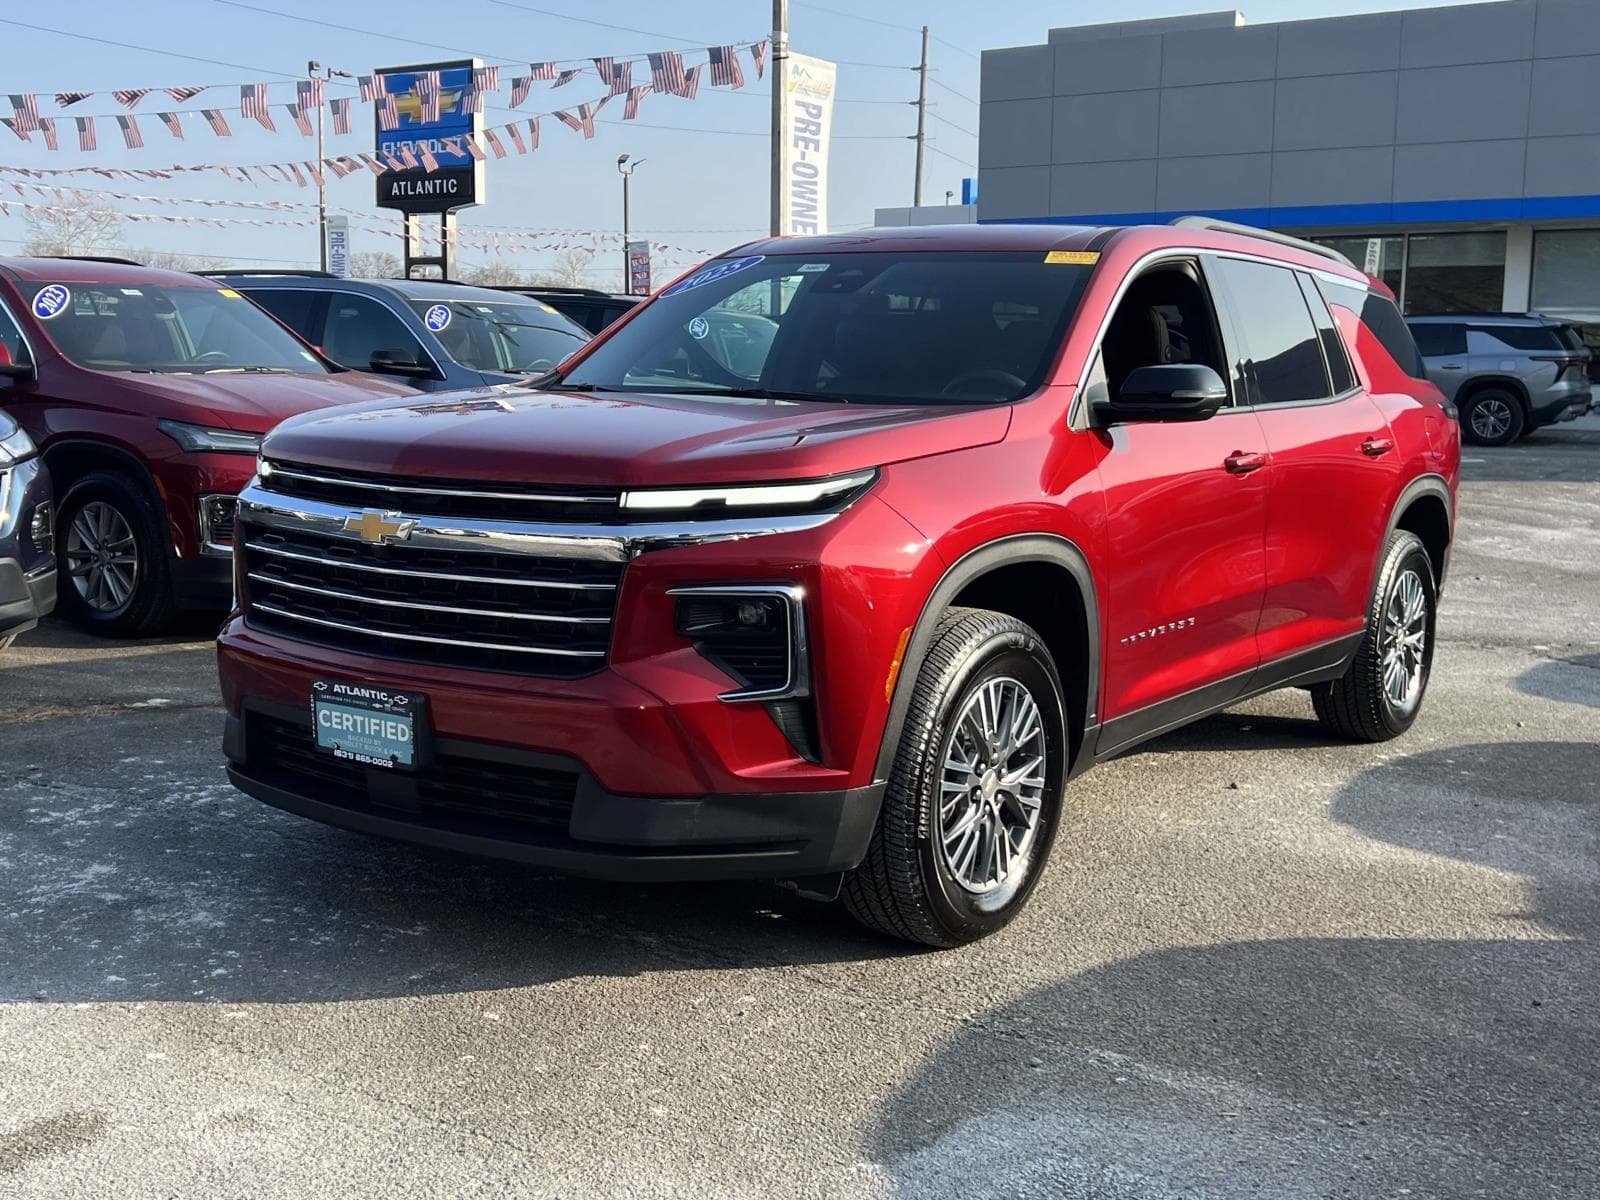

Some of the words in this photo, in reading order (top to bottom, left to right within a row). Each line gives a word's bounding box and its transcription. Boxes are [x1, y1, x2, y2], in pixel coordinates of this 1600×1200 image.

[382, 136, 462, 156] CHVOLT
[391, 178, 458, 196] ATLANTIC
[331, 231, 345, 278] PRE-OWN
[38, 287, 65, 314] 2023
[333, 684, 388, 701] ATLANTIC
[319, 709, 410, 742] CERTIFIED
